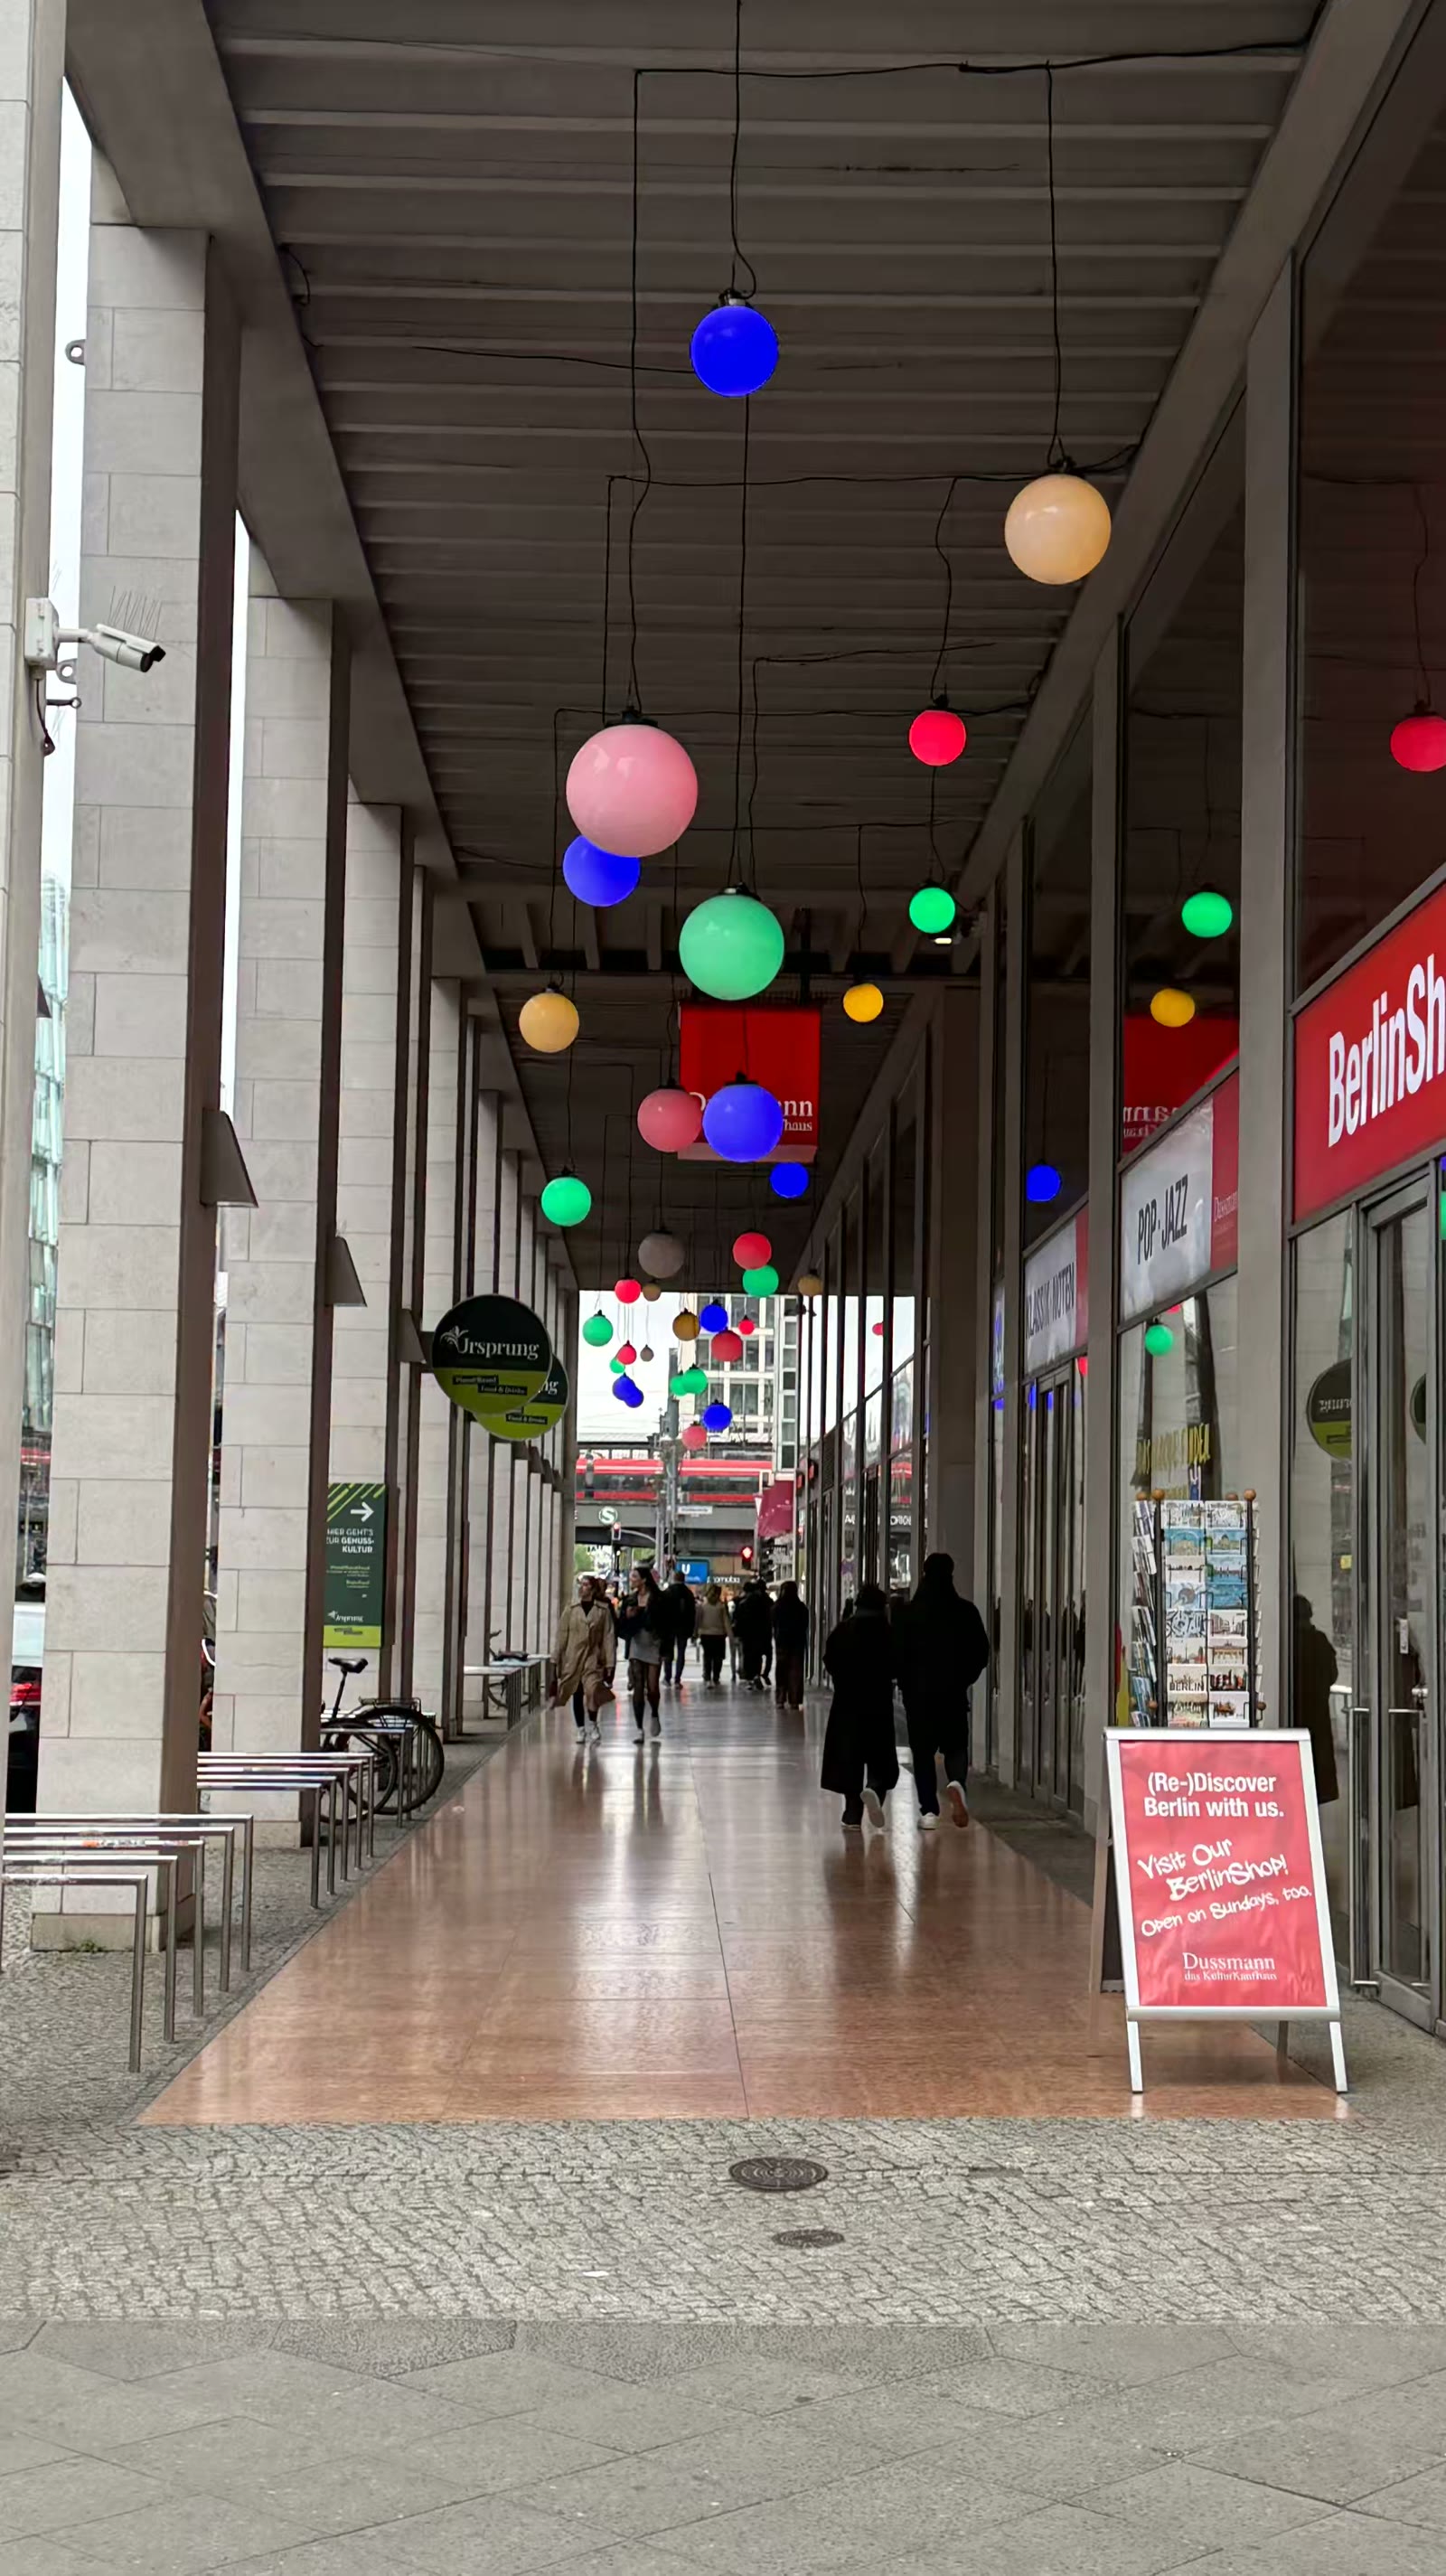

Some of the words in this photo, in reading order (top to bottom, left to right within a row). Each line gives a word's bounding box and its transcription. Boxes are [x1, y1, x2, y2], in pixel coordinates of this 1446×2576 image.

[1138, 1199, 1157, 1265] POP
[1162, 1173, 1188, 1251] JAZZ
[451, 1332, 540, 1360] Ursprung
[342, 1545, 373, 1554] KULTUR
[681, 1563, 690, 1575] U
[1169, 1681, 1205, 1692] BERLIN
[1148, 1772, 1277, 1796] (Re-)Discover
[1144, 1797, 1200, 1818] Berlin
[1206, 1797, 1249, 1818] with
[1255, 1800, 1284, 1818] us.
[1137, 1851, 1186, 1880] Visit
[1192, 1838, 1233, 1866] Our
[1166, 1854, 1290, 1901] BerlinShop!
[1141, 1913, 1183, 1937] Open
[1188, 1909, 1207, 1924] on
[1209, 1892, 1280, 1920] Sundays,
[1282, 1885, 1313, 1902] too.
[1182, 1951, 1275, 1970] Dussmann
[1185, 1970, 1200, 1980] das
